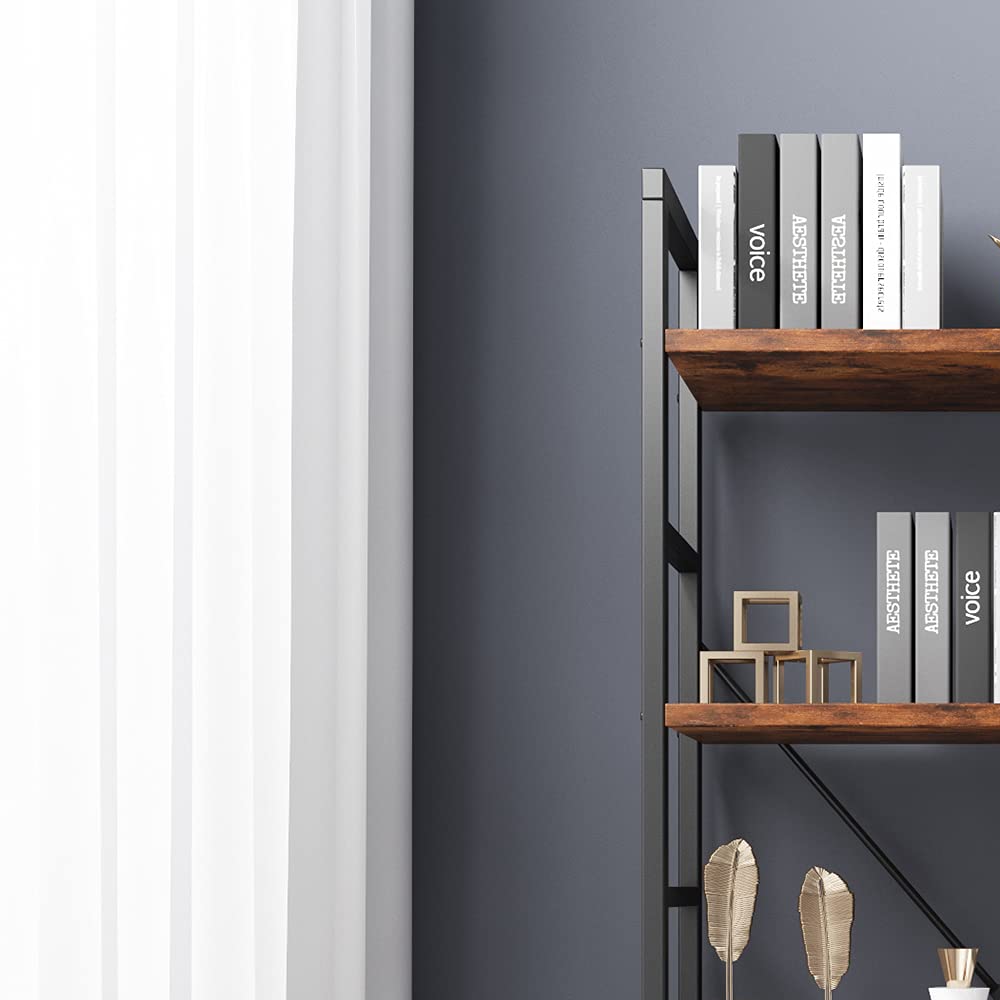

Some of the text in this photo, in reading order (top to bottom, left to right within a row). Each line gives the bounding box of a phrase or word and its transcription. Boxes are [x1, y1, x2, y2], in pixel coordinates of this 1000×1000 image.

[750, 224, 770, 282] voice
[792, 214, 808, 304] AESTHETE
[886, 550, 900, 634] AESTHETE
[925, 550, 939, 634] AESTHETE
[960, 570, 980, 625] voice
